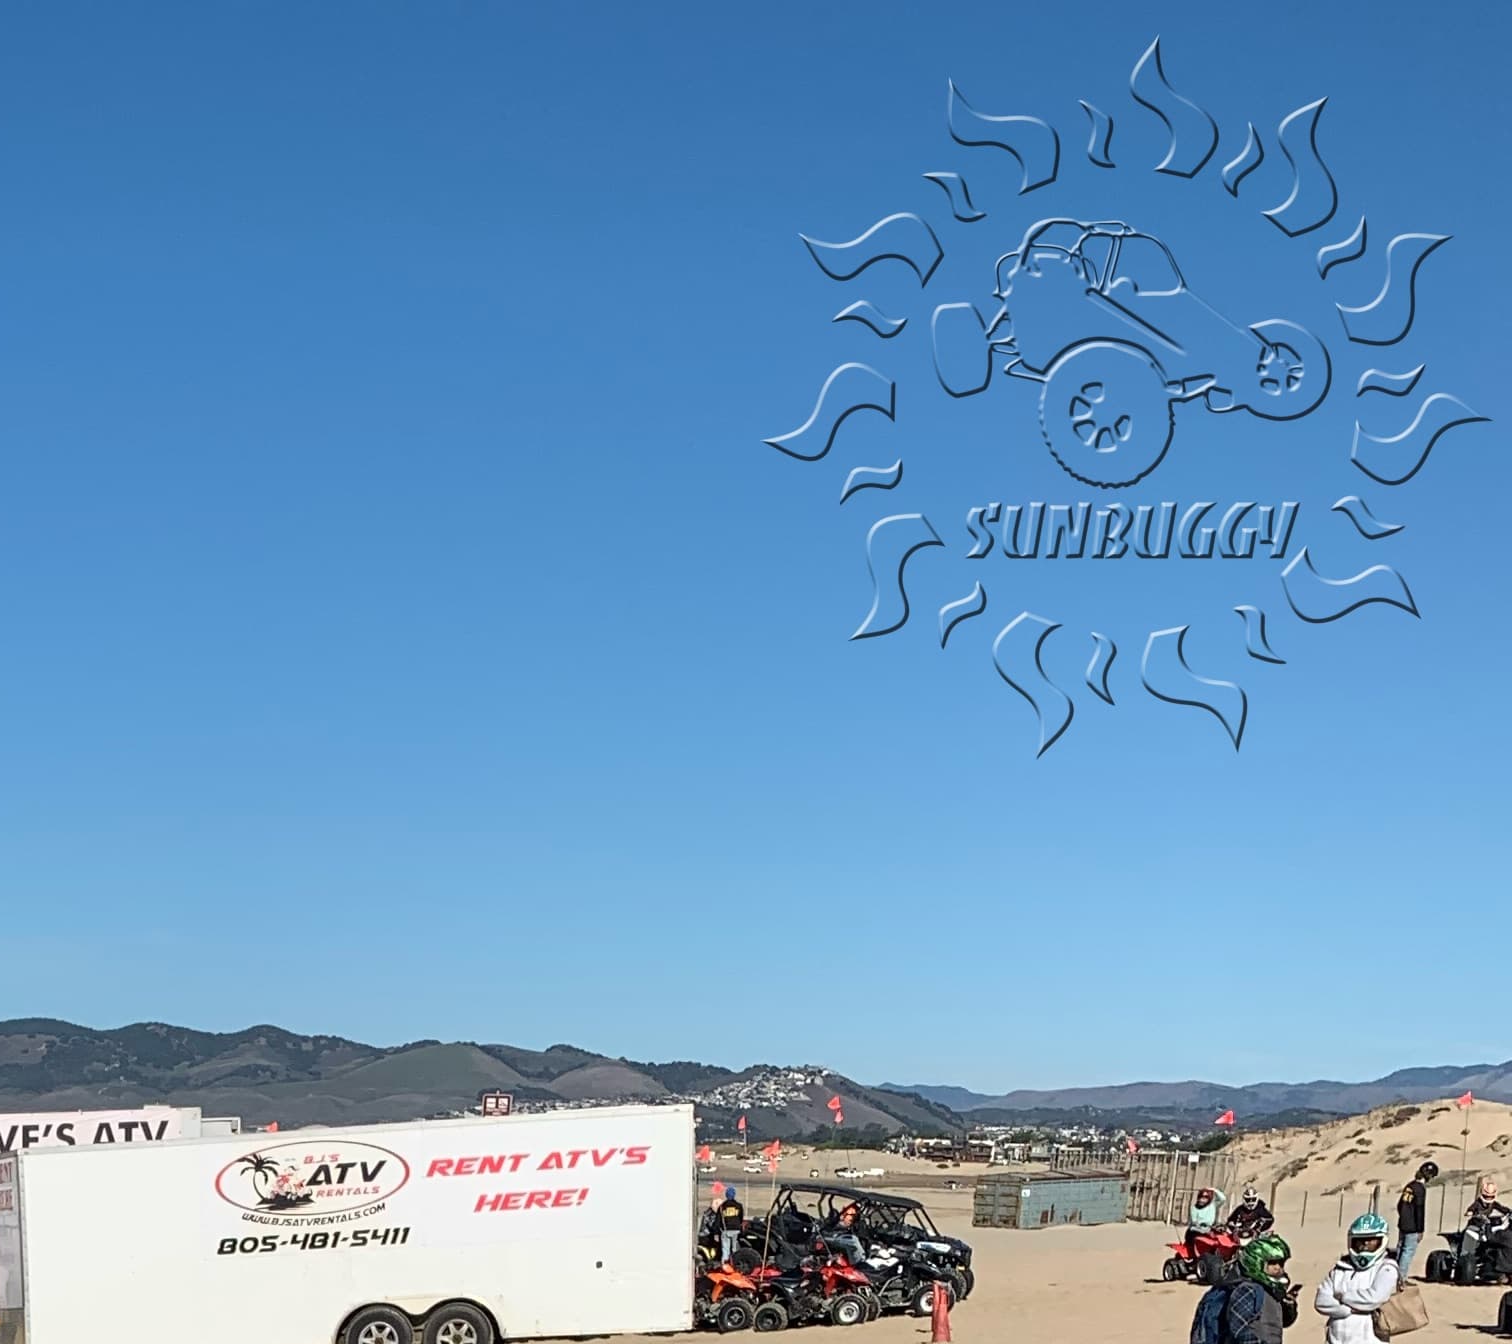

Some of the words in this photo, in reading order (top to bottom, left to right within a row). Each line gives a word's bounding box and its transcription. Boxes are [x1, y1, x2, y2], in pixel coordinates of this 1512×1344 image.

[93, 1120, 169, 1144] ATV
[306, 1160, 386, 1186] ATV
[426, 1153, 530, 1178] RENT
[536, 1146, 652, 1170] ATV'S
[316, 1186, 380, 1198] RENTALS
[473, 1188, 589, 1212] HERE!
[217, 1227, 410, 1255] 805-481-5411
